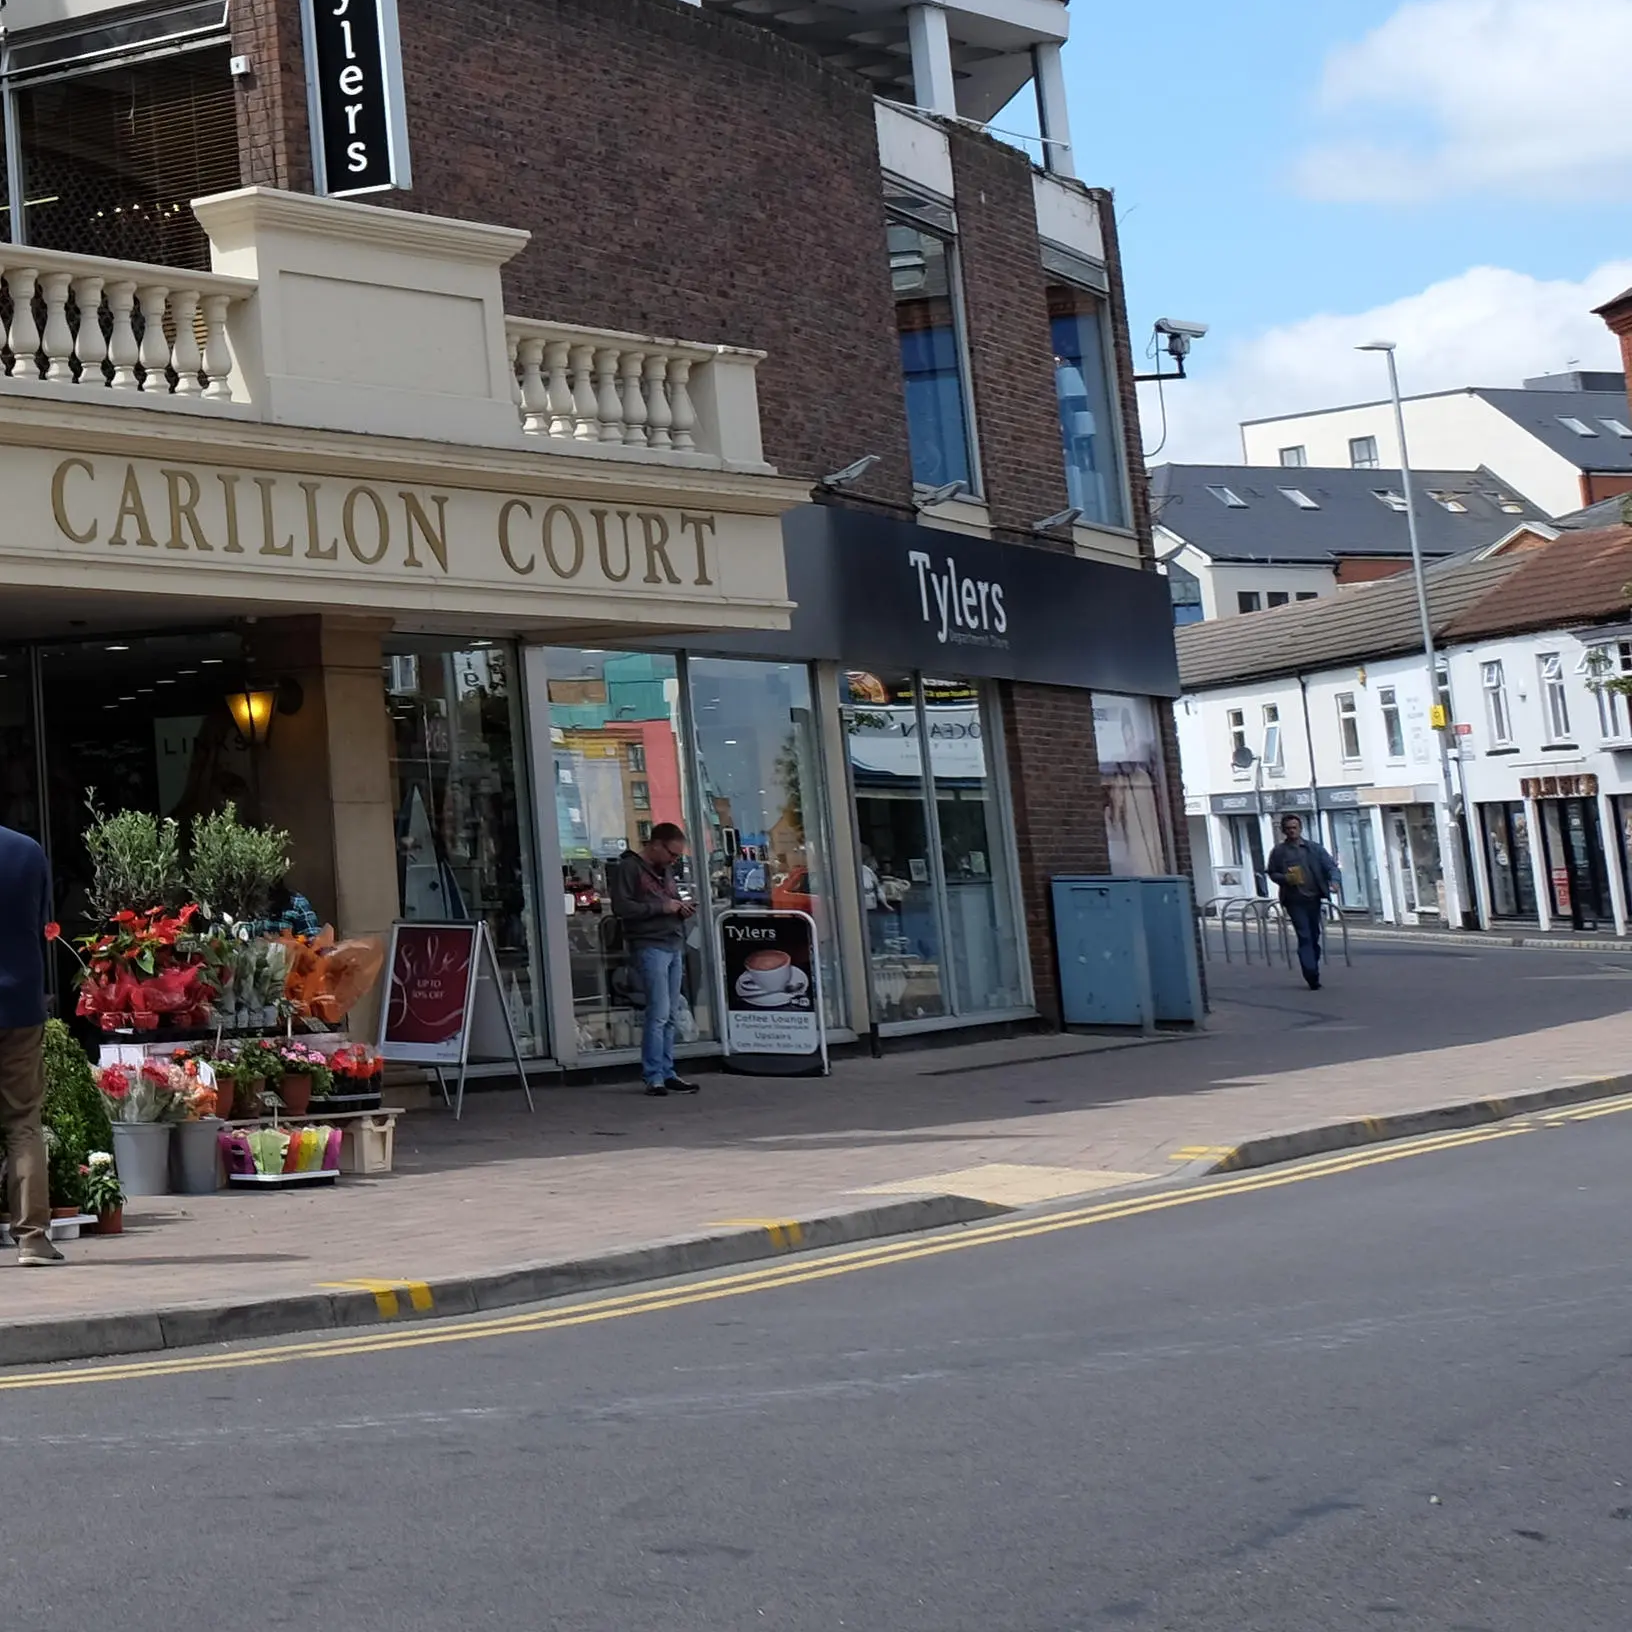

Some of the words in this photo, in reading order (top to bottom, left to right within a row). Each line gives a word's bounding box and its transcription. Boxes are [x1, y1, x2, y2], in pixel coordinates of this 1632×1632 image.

[51, 458, 449, 574] CARILLON
[497, 498, 716, 586] COURT
[908, 549, 1007, 644] Tylers
[724, 925, 777, 942] Tylers
[734, 1013, 768, 1023] Coffee
[770, 1014, 809, 1024] Lounge
[754, 1031, 792, 1041] Upstairs
